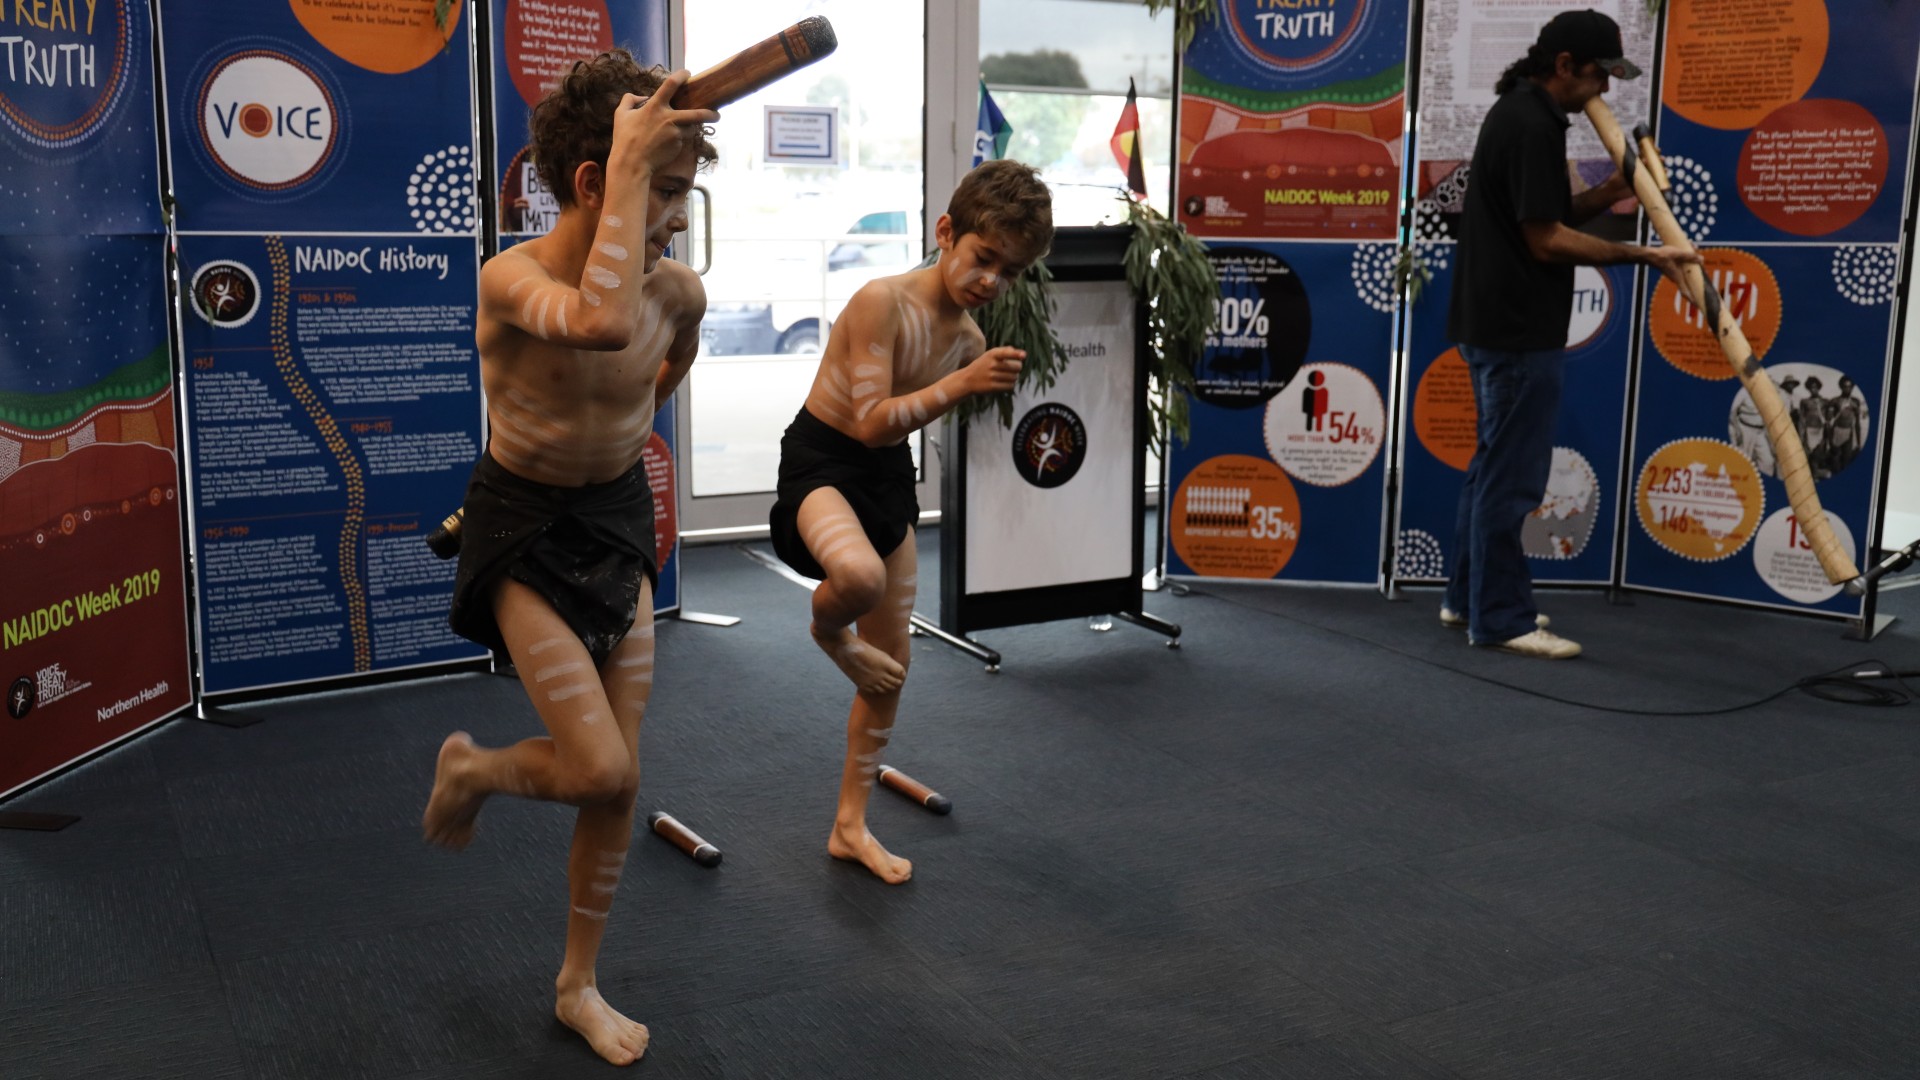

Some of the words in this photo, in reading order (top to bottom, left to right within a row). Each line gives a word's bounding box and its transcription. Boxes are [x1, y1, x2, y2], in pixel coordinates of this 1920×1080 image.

[0, 0, 96, 35] REATY
[1255, 11, 1334, 40] TRUTH
[0, 36, 95, 87] TRUTH
[214, 102, 322, 140] VOICE
[1264, 189, 1317, 205] NAIDOC
[1318, 189, 1355, 205] Week
[1357, 190, 1390, 206] 2019
[296, 246, 372, 273] NAIDOC
[379, 245, 449, 280] History
[1063, 342, 1106, 358] Health
[1222, 335, 1268, 349] mothers
[1329, 411, 1375, 444] 54%
[1647, 466, 1692, 495] 2,253
[1251, 505, 1297, 540] 35%
[1661, 505, 1688, 533] 146
[3, 600, 74, 650] NAIDOC
[75, 584, 122, 621] Week
[123, 568, 160, 604] 2019
[36, 662, 60, 681] VOICE
[37, 670, 67, 691] TREATY
[37, 682, 65, 702] TRUTH
[97, 694, 140, 723] Northern
[139, 680, 169, 704] Health
